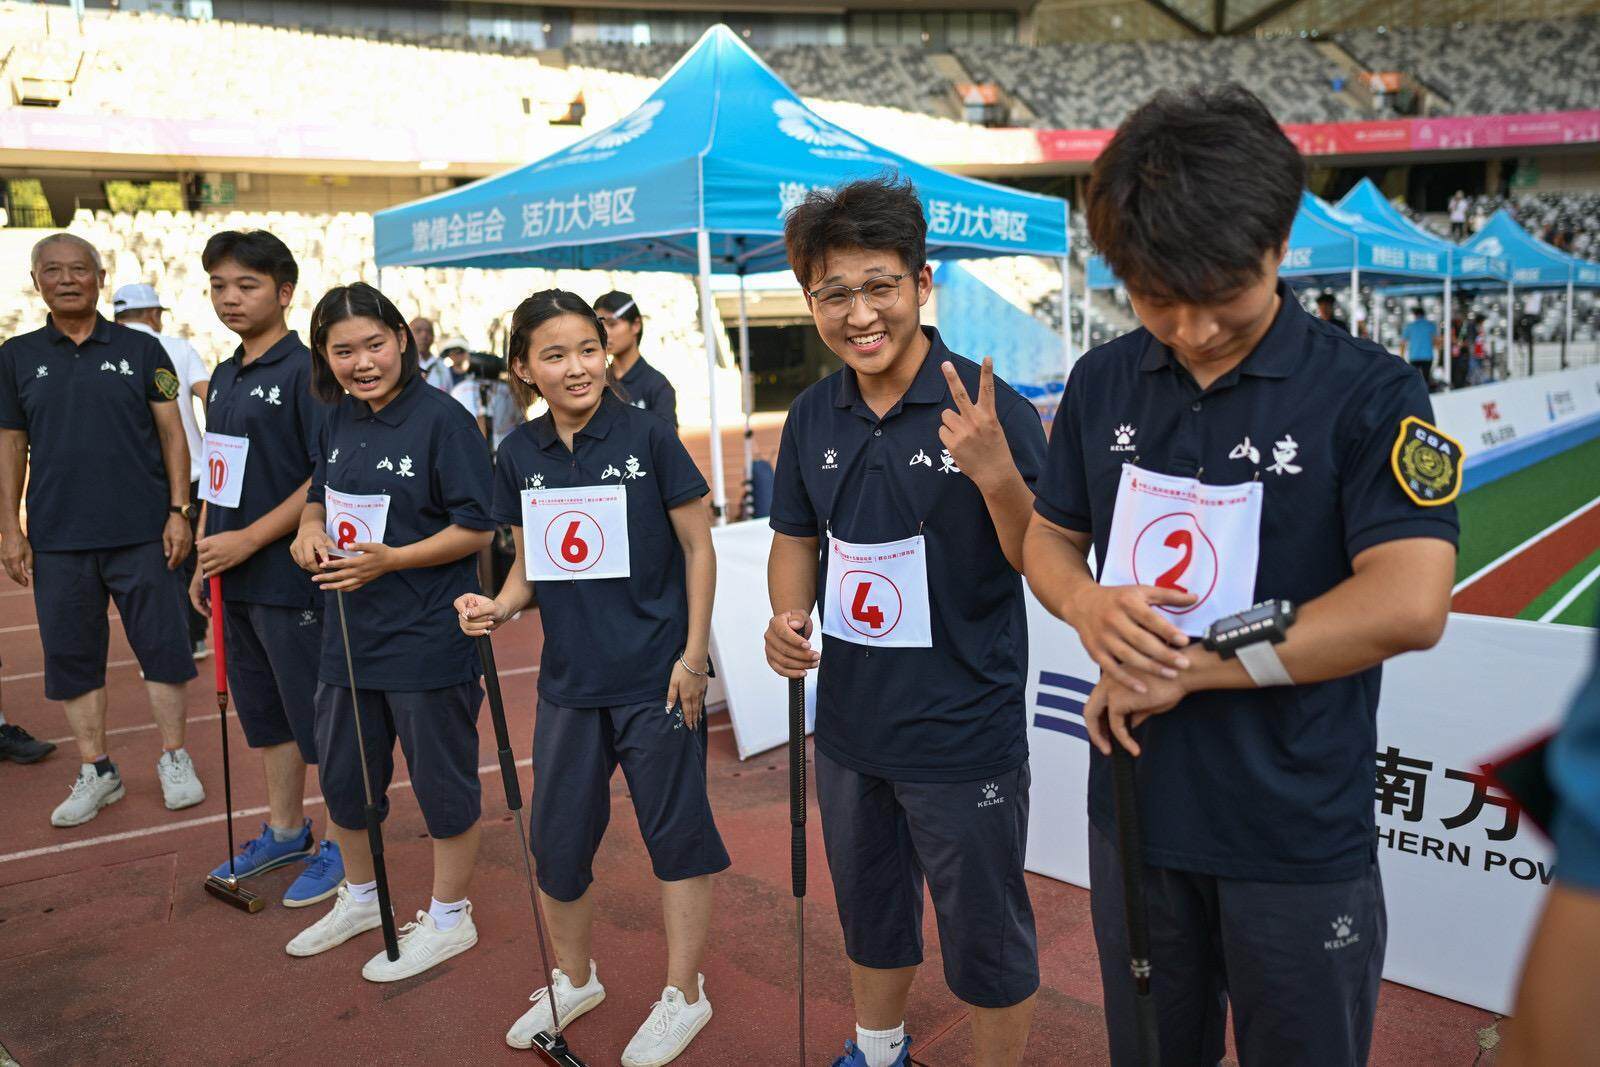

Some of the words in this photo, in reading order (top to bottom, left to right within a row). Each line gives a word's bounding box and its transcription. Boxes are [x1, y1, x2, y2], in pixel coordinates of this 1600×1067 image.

[521, 186, 637, 239] 活力大湾区
[928, 199, 1028, 242] 活力大湾区
[208, 458, 225, 492] 10
[337, 521, 357, 550] 8
[560, 520, 589, 564] 6
[1154, 529, 1194, 594] 2
[851, 581, 885, 630] 4
[977, 796, 1005, 808] KELME
[1375, 745, 1522, 842] 南方
[1323, 932, 1361, 950] KELME
